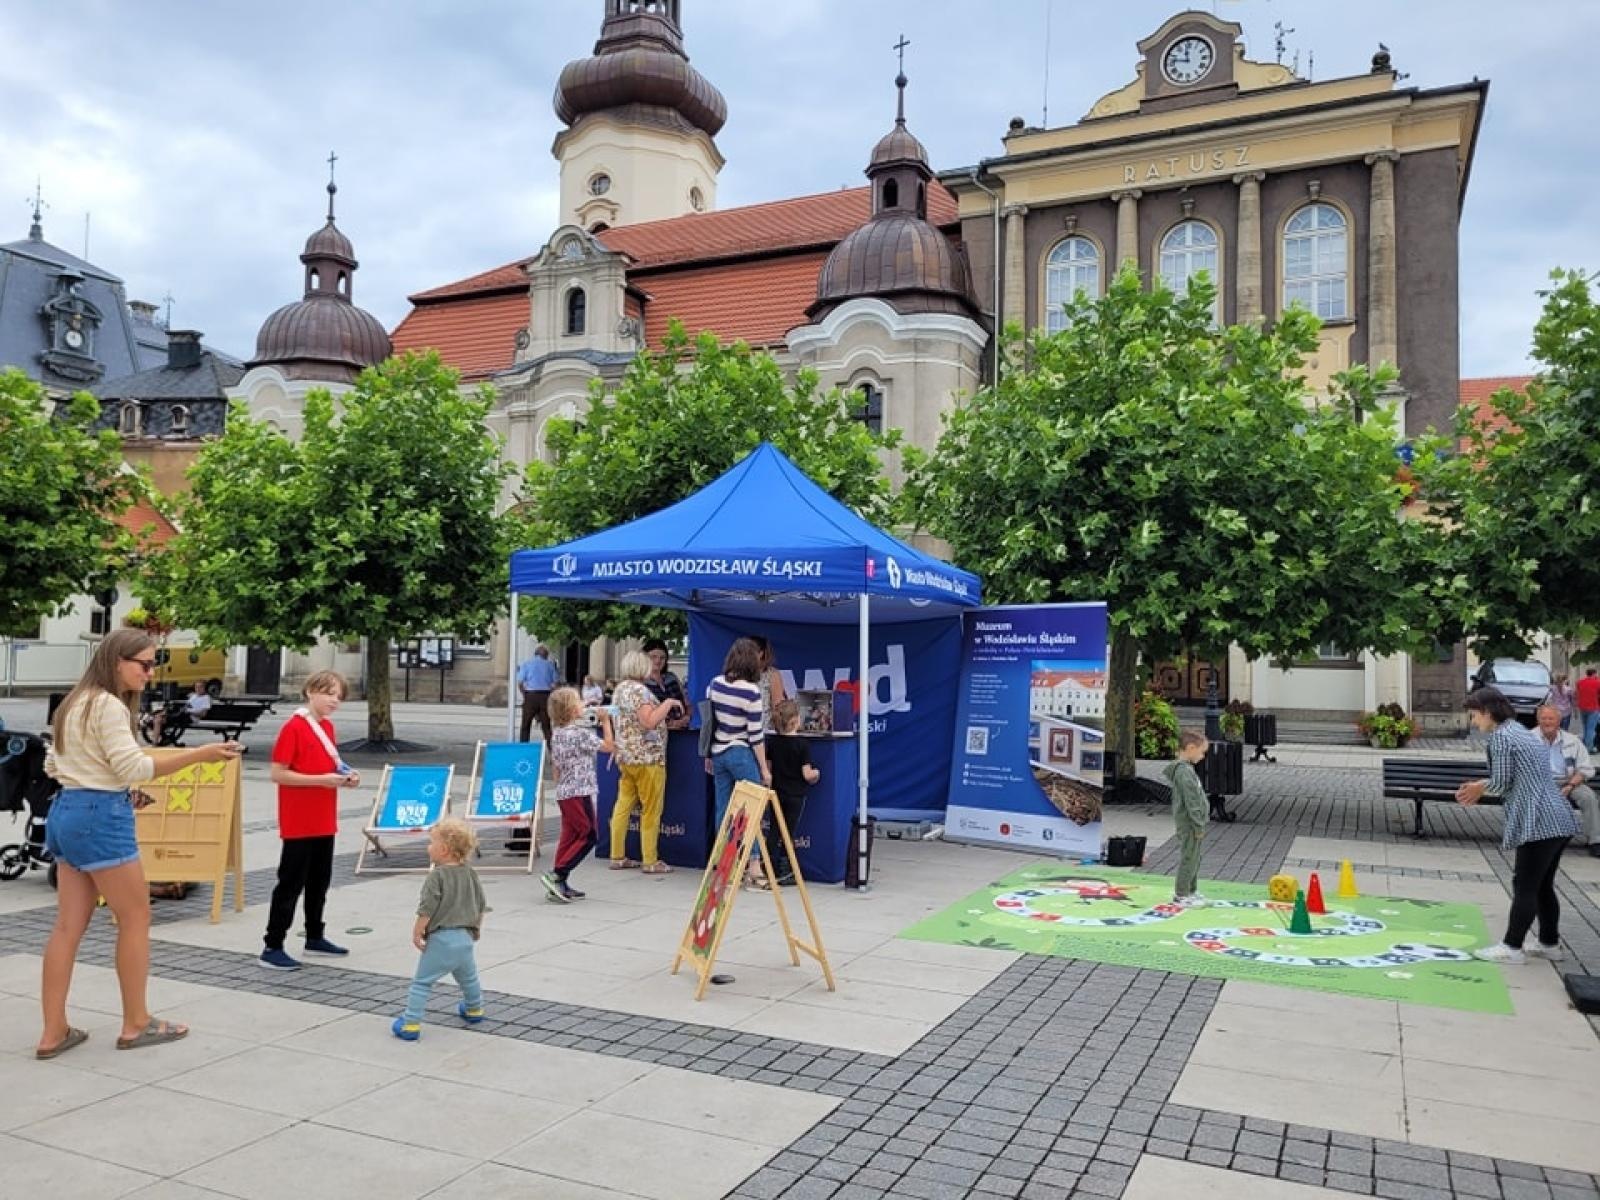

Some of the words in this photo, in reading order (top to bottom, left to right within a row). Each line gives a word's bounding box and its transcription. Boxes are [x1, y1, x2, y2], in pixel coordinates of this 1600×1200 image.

[1123, 146, 1249, 184] RATUSZ
[592, 560, 654, 577] MIASTO
[657, 559, 759, 575] WODZISŁAW
[762, 556, 823, 580] ŚLĄSKI
[975, 622, 1013, 632] Muzeum
[1039, 631, 1078, 647] Śląskim
